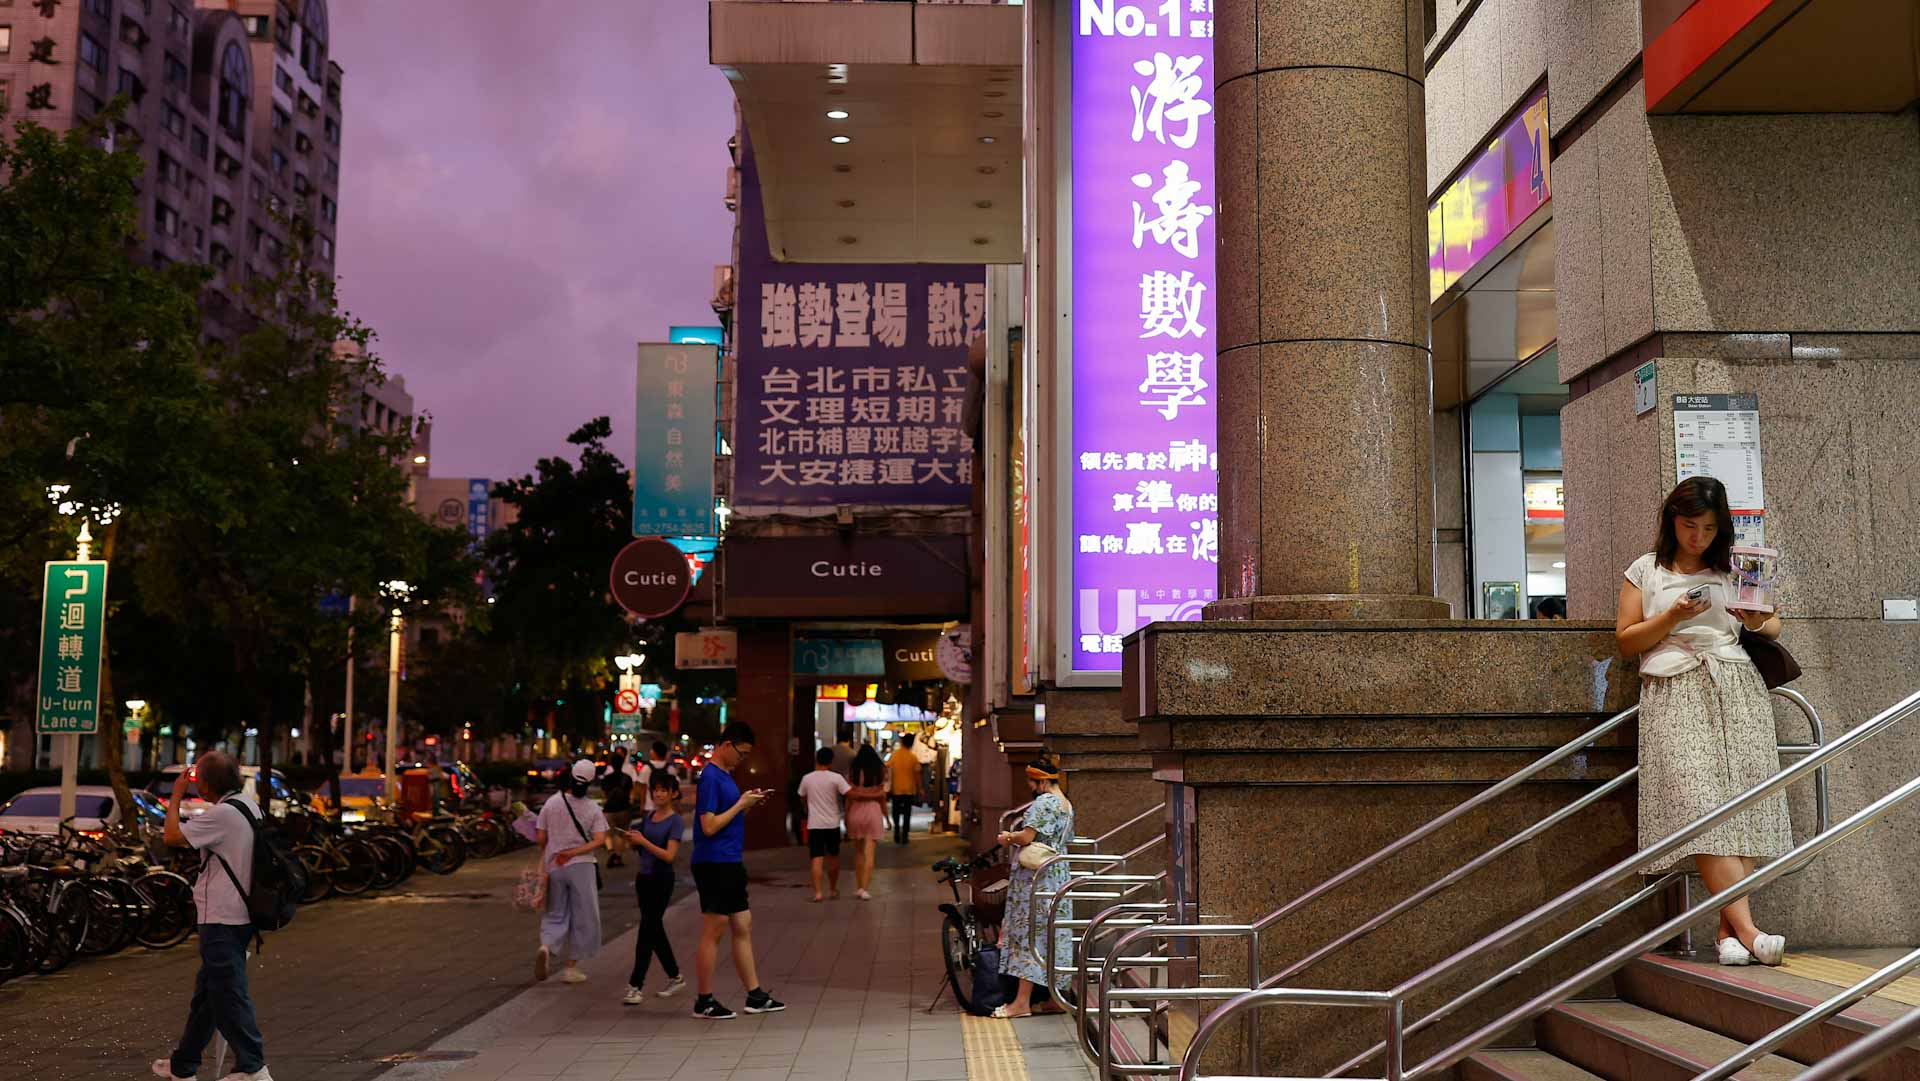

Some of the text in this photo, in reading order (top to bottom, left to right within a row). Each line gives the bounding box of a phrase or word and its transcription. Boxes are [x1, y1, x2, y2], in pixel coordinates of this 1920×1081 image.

[1080, 0, 1181, 37] No.1
[1531, 127, 1545, 203] 4
[761, 281, 907, 348] 強勢登場
[1080, 439, 1218, 472] 領先貴於神
[624, 571, 677, 586] Cutie
[811, 561, 882, 578] Cutie
[57, 602, 85, 692] 迴轉道
[1080, 635, 1124, 653] 電話
[895, 649, 934, 662] Cuti
[42, 696, 92, 711] U-turn
[41, 714, 78, 729] Lane
